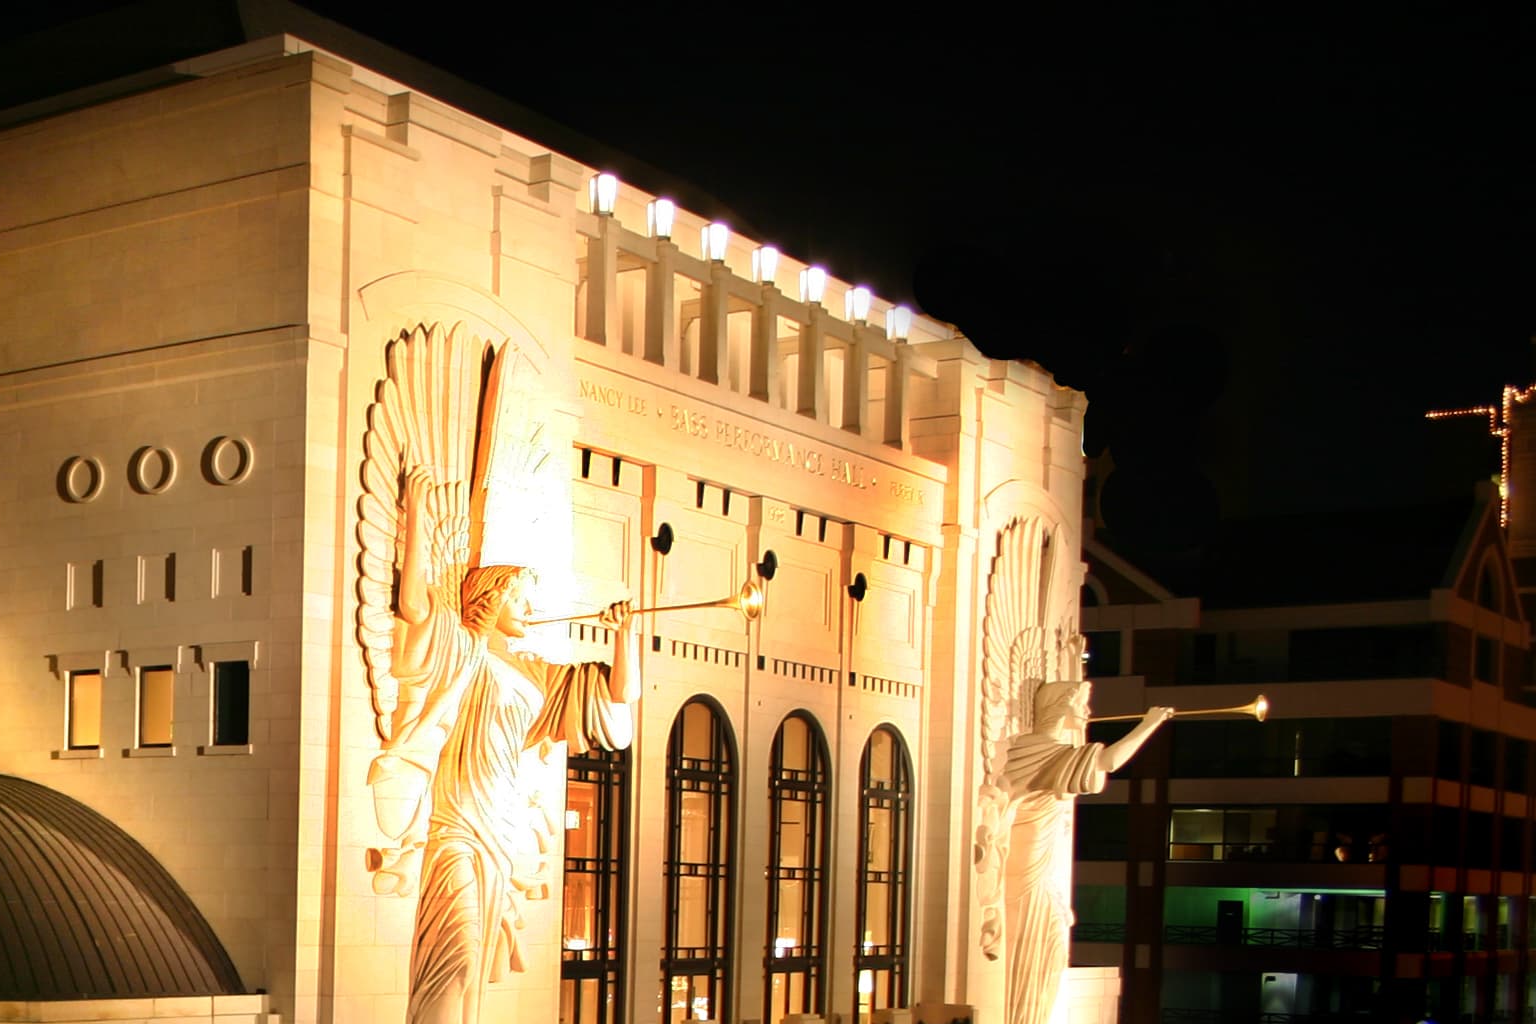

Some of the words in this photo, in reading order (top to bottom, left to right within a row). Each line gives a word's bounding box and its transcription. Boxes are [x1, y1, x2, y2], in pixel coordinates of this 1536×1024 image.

[579, 379, 624, 409] NANCY
[628, 395, 648, 416] LEE
[671, 405, 708, 440] BASS
[716, 420, 825, 476] PERFORMANCE
[831, 457, 867, 489] HALL
